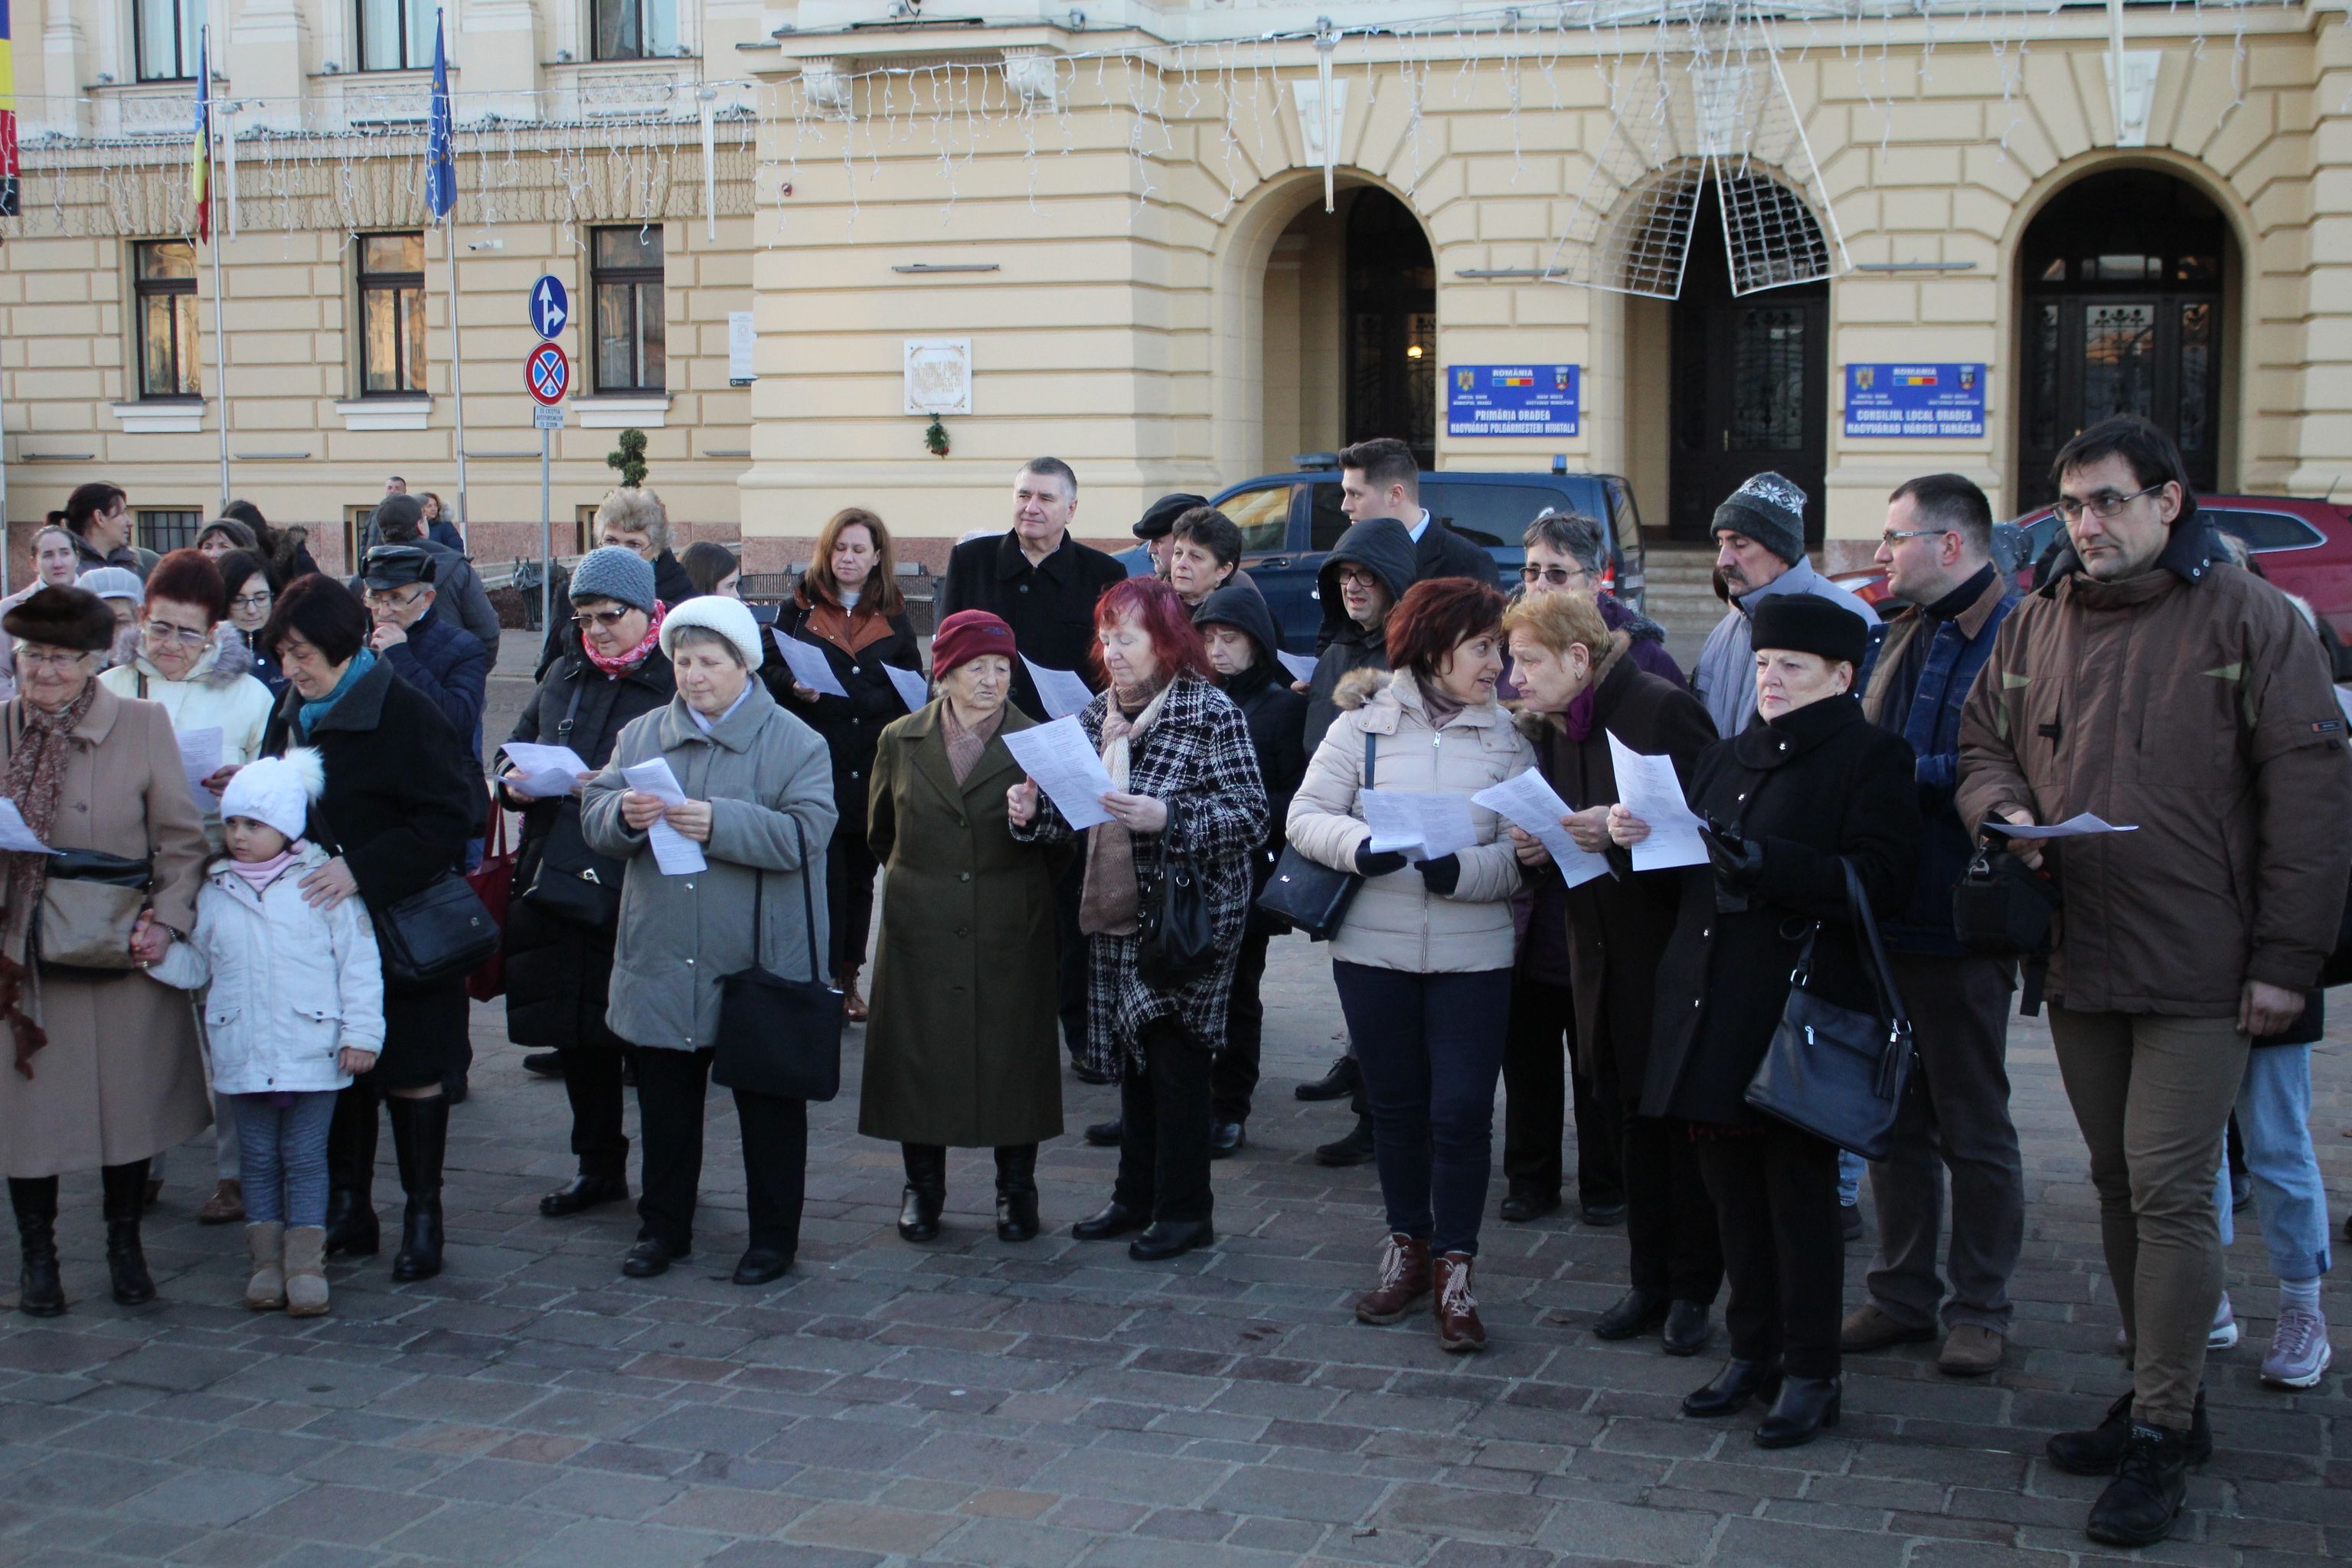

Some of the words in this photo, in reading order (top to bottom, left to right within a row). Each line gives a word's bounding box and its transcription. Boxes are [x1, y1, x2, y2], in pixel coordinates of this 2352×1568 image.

[1518, 410, 1551, 421] ORADEA
[1857, 410, 1904, 421] CONSILIUL
[1906, 410, 1935, 421] LOCAL
[1936, 410, 1973, 421] ORADEA
